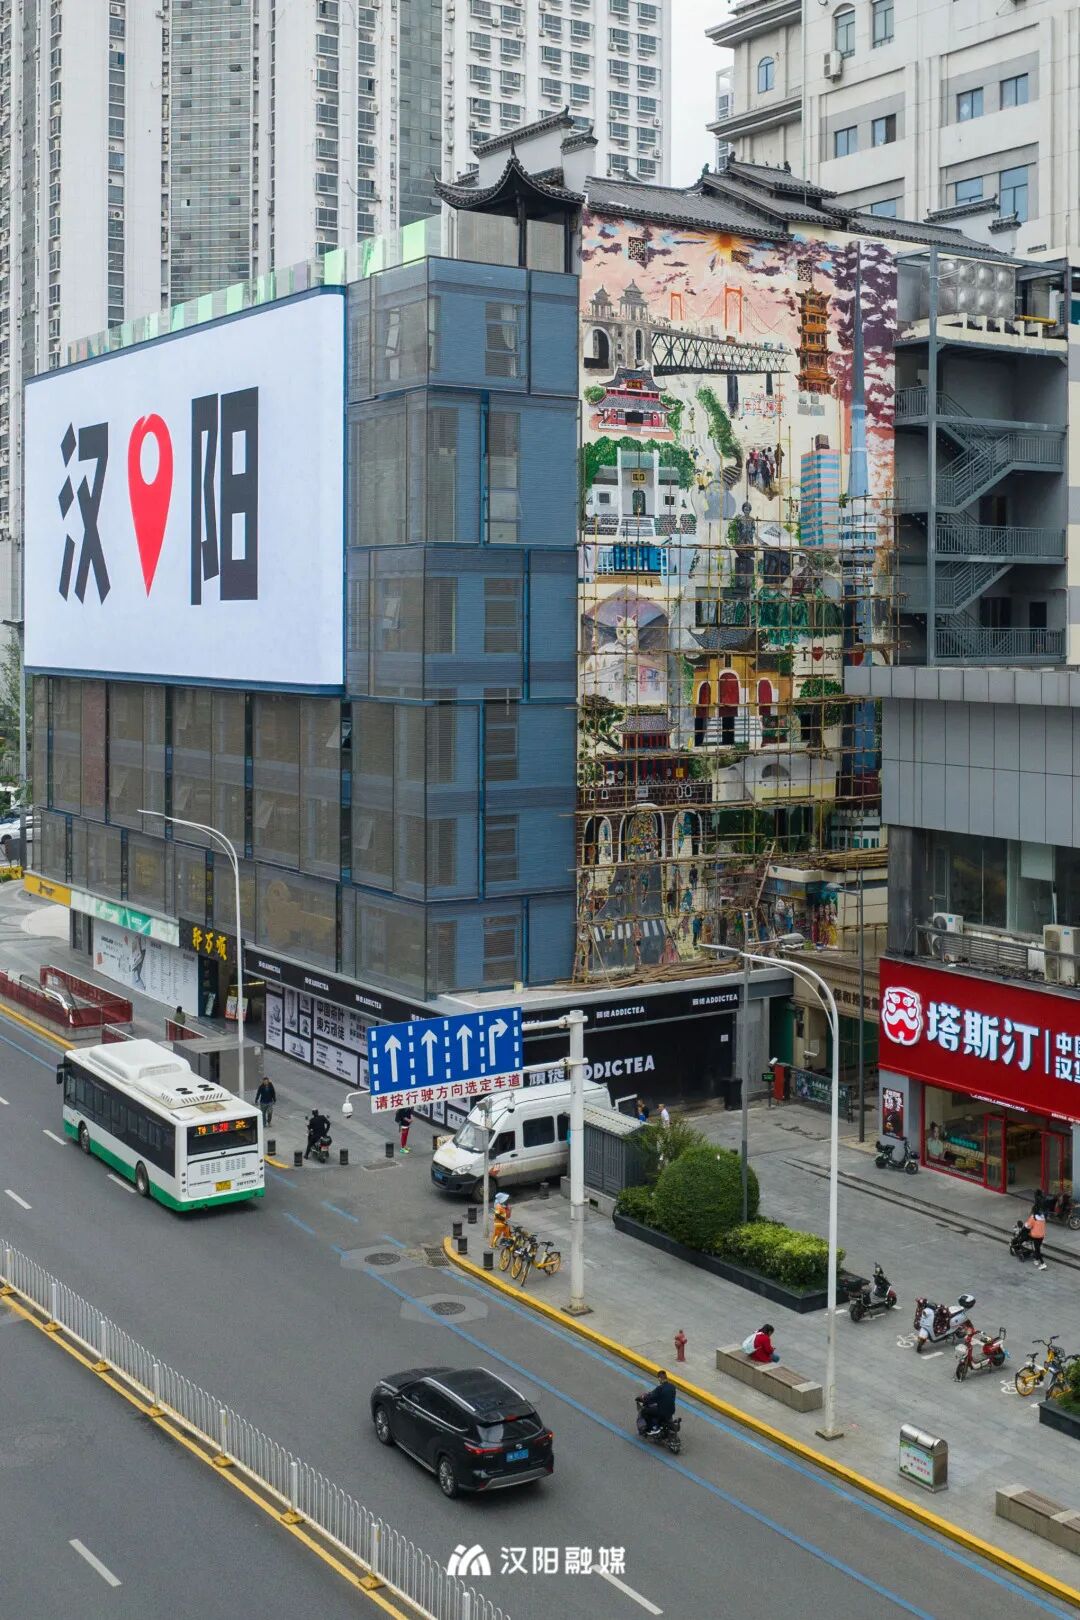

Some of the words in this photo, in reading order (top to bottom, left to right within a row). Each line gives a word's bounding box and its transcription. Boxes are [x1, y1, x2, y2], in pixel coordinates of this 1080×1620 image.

[927, 1001, 1039, 1071] 塔斯汀
[583, 1055, 655, 1080] DDICTEA
[374, 1072, 521, 1110] 请按行驶方向选定车道
